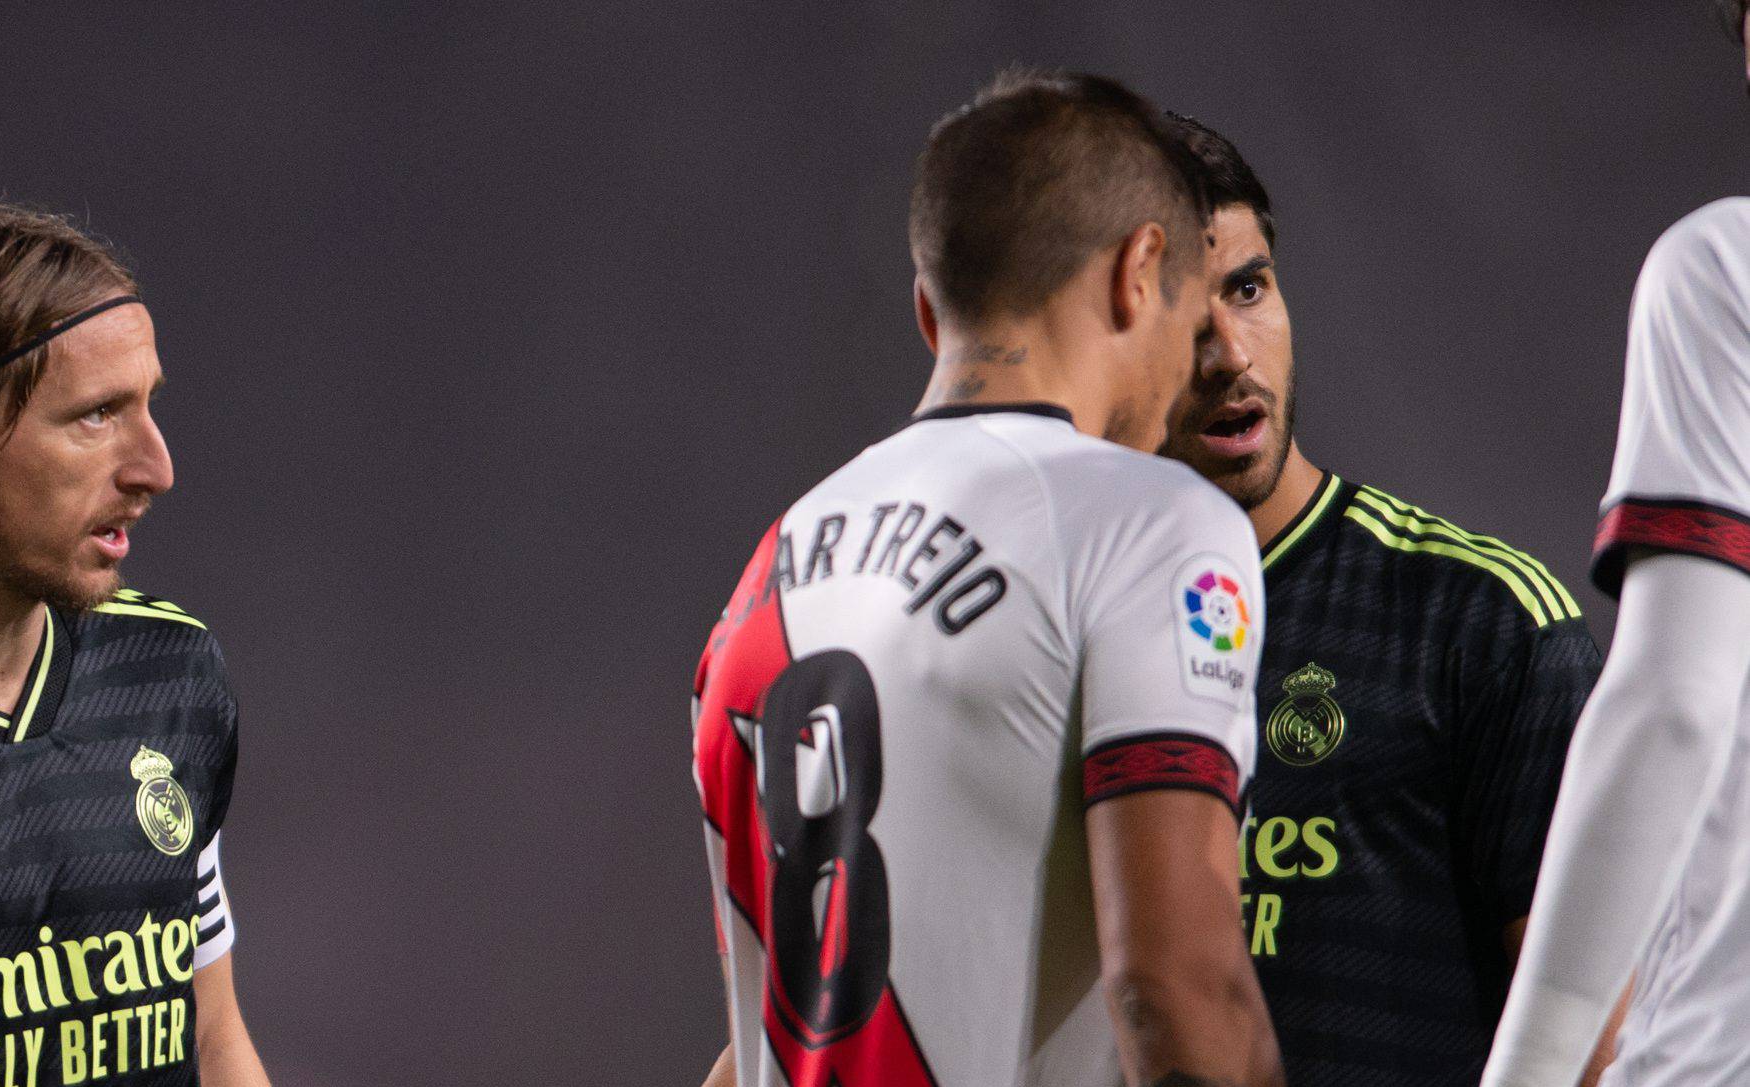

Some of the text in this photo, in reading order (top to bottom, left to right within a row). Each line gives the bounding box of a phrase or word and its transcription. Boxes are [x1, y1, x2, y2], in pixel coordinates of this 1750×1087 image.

[853, 499, 1009, 638] TREJO
[753, 646, 891, 1051] 8
[60, 997, 187, 1086] BETTER
